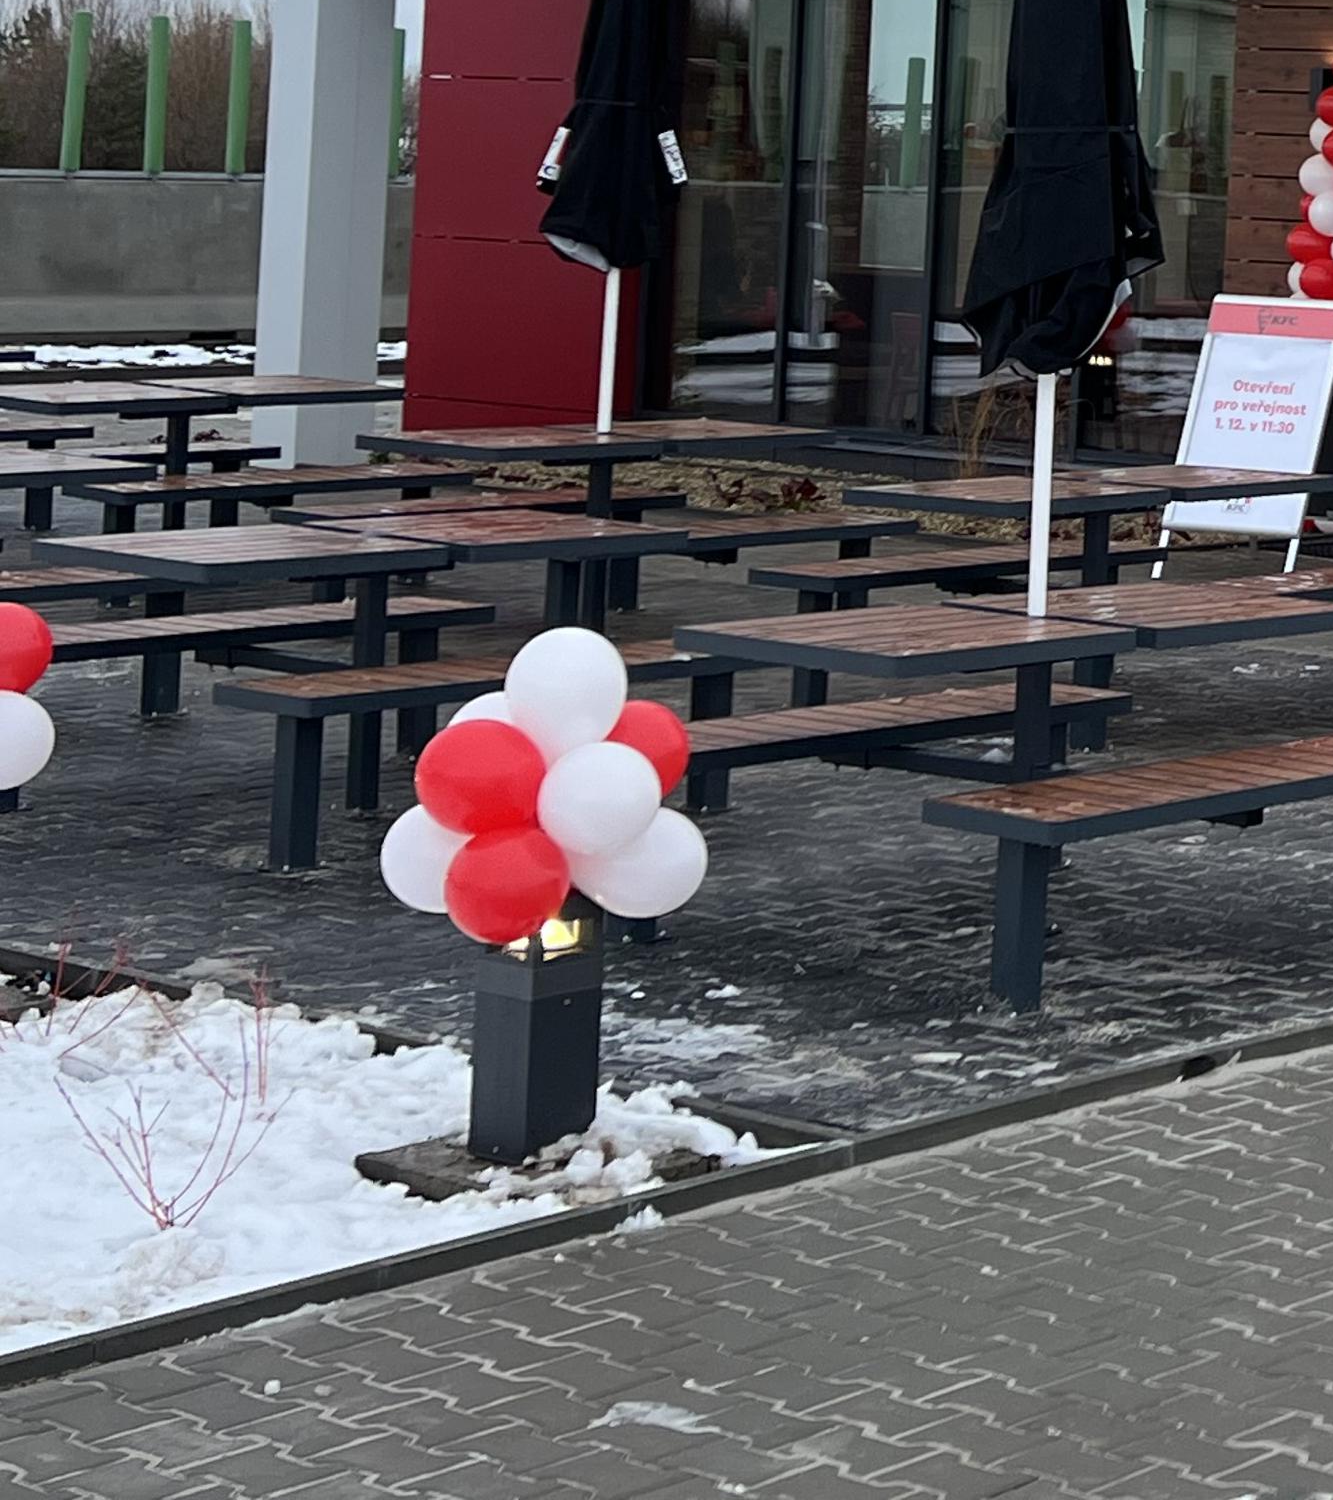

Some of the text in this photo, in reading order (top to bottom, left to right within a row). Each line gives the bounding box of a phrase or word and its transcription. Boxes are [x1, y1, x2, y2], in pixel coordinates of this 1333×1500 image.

[1233, 379, 1295, 395] Otevření
[1213, 399, 1307, 416] pro veřejnost
[1229, 418, 1245, 431] 12.
[1250, 421, 1257, 432] v
[1262, 419, 1295, 434] 11:30
